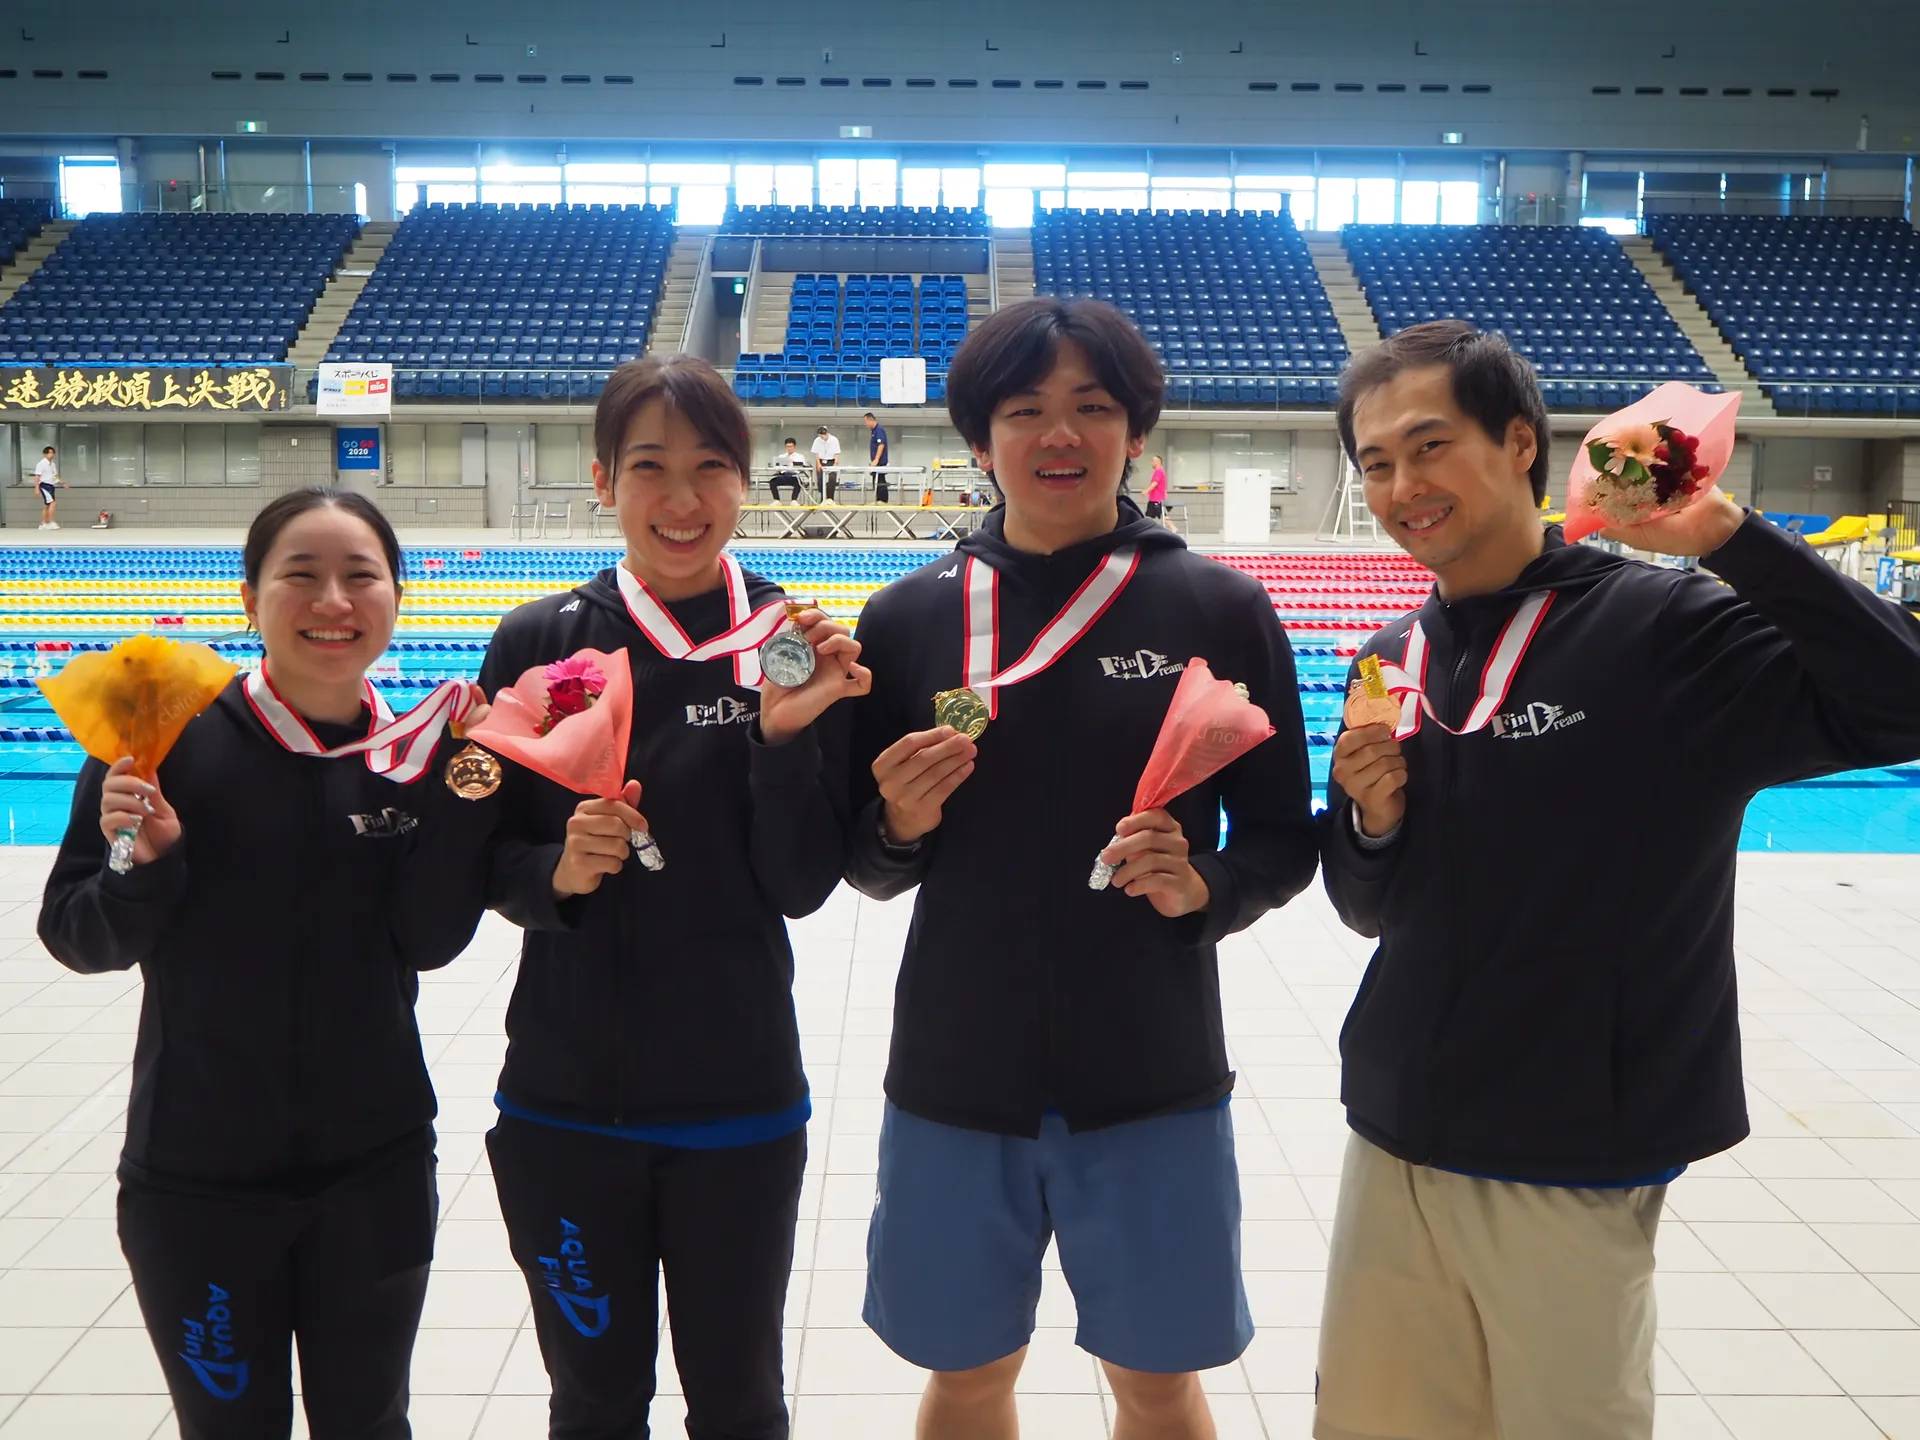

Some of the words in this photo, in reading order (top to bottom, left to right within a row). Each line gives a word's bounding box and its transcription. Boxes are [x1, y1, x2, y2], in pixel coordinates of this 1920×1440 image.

[0, 368, 275, 410] 速競技頂上決戦
[334, 369, 379, 378] スポーツくじ
[342, 440, 358, 448] GO
[560, 1217, 593, 1291] AQUA
[207, 1282, 236, 1359] AQUA
